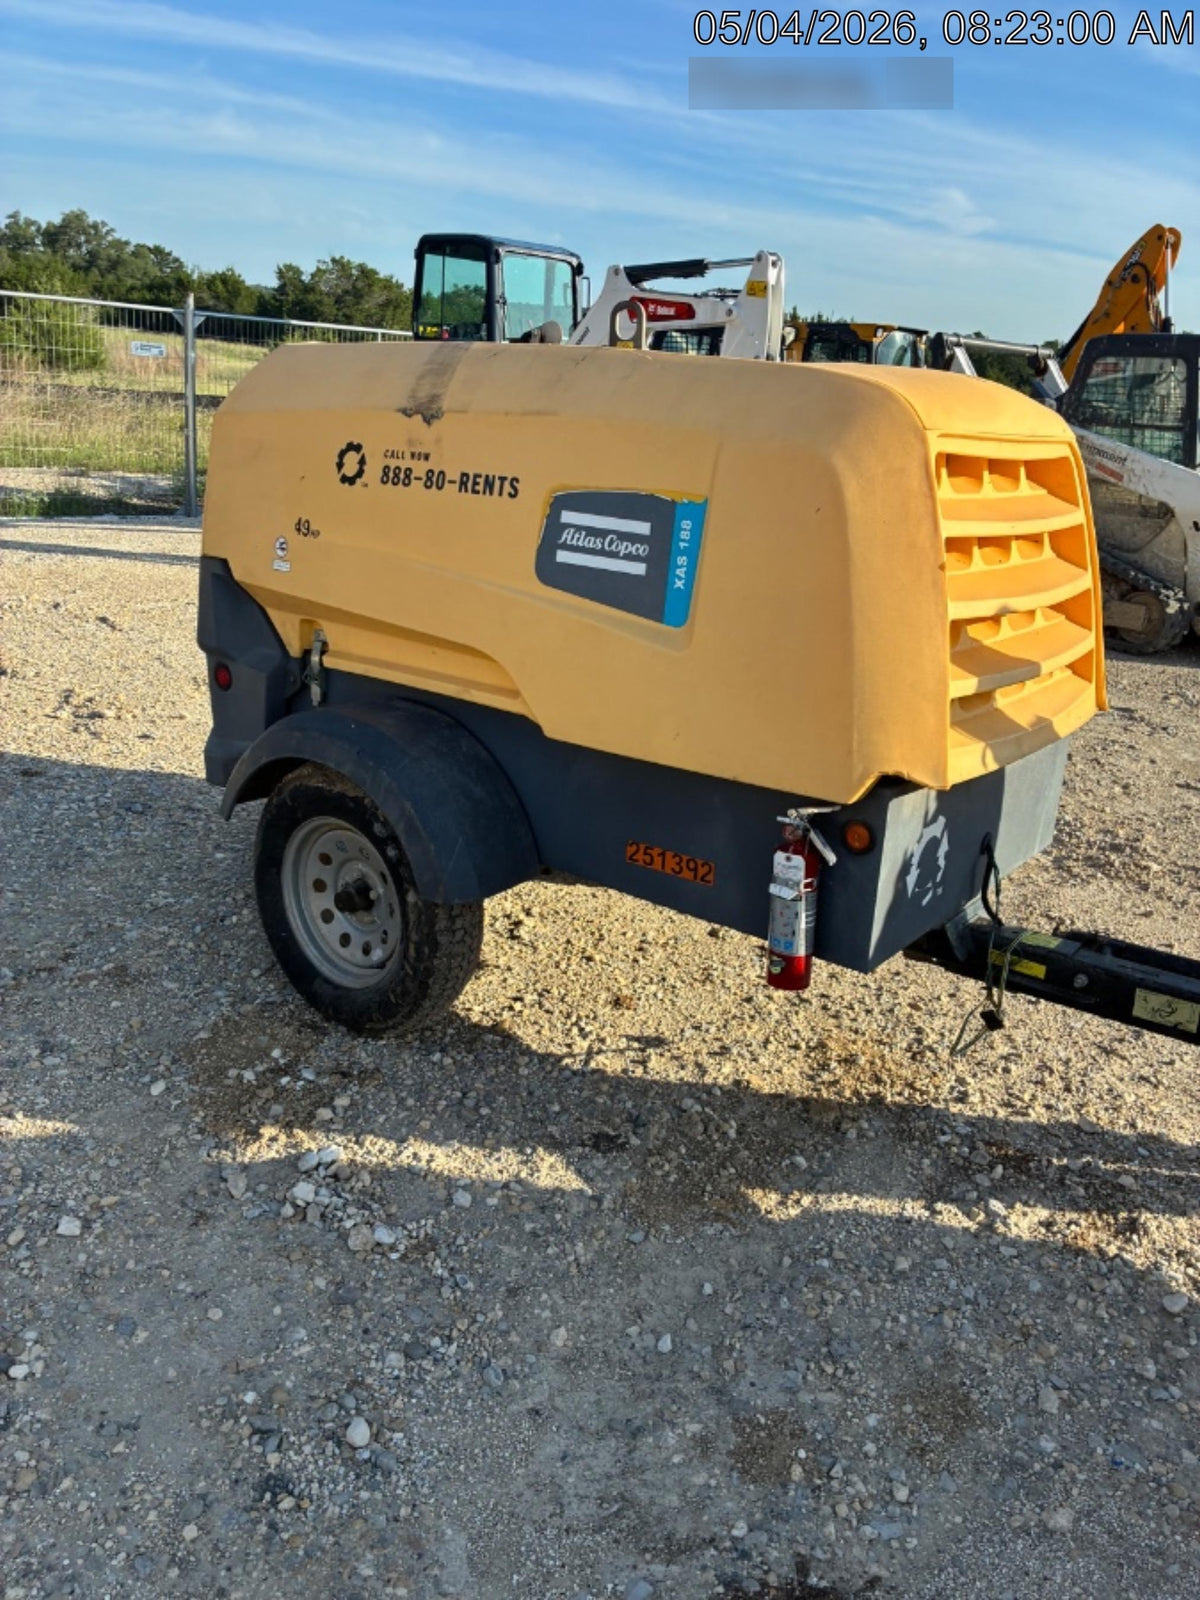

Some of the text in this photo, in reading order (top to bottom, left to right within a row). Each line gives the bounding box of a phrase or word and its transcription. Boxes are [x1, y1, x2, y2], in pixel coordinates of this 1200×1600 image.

[383, 449, 431, 462] CALL NOW
[380, 464, 520, 499] 888-80-RENTS
[558, 527, 650, 557] Atlas Copco
[673, 519, 693, 590] XAS 188
[627, 841, 714, 884] 251392
